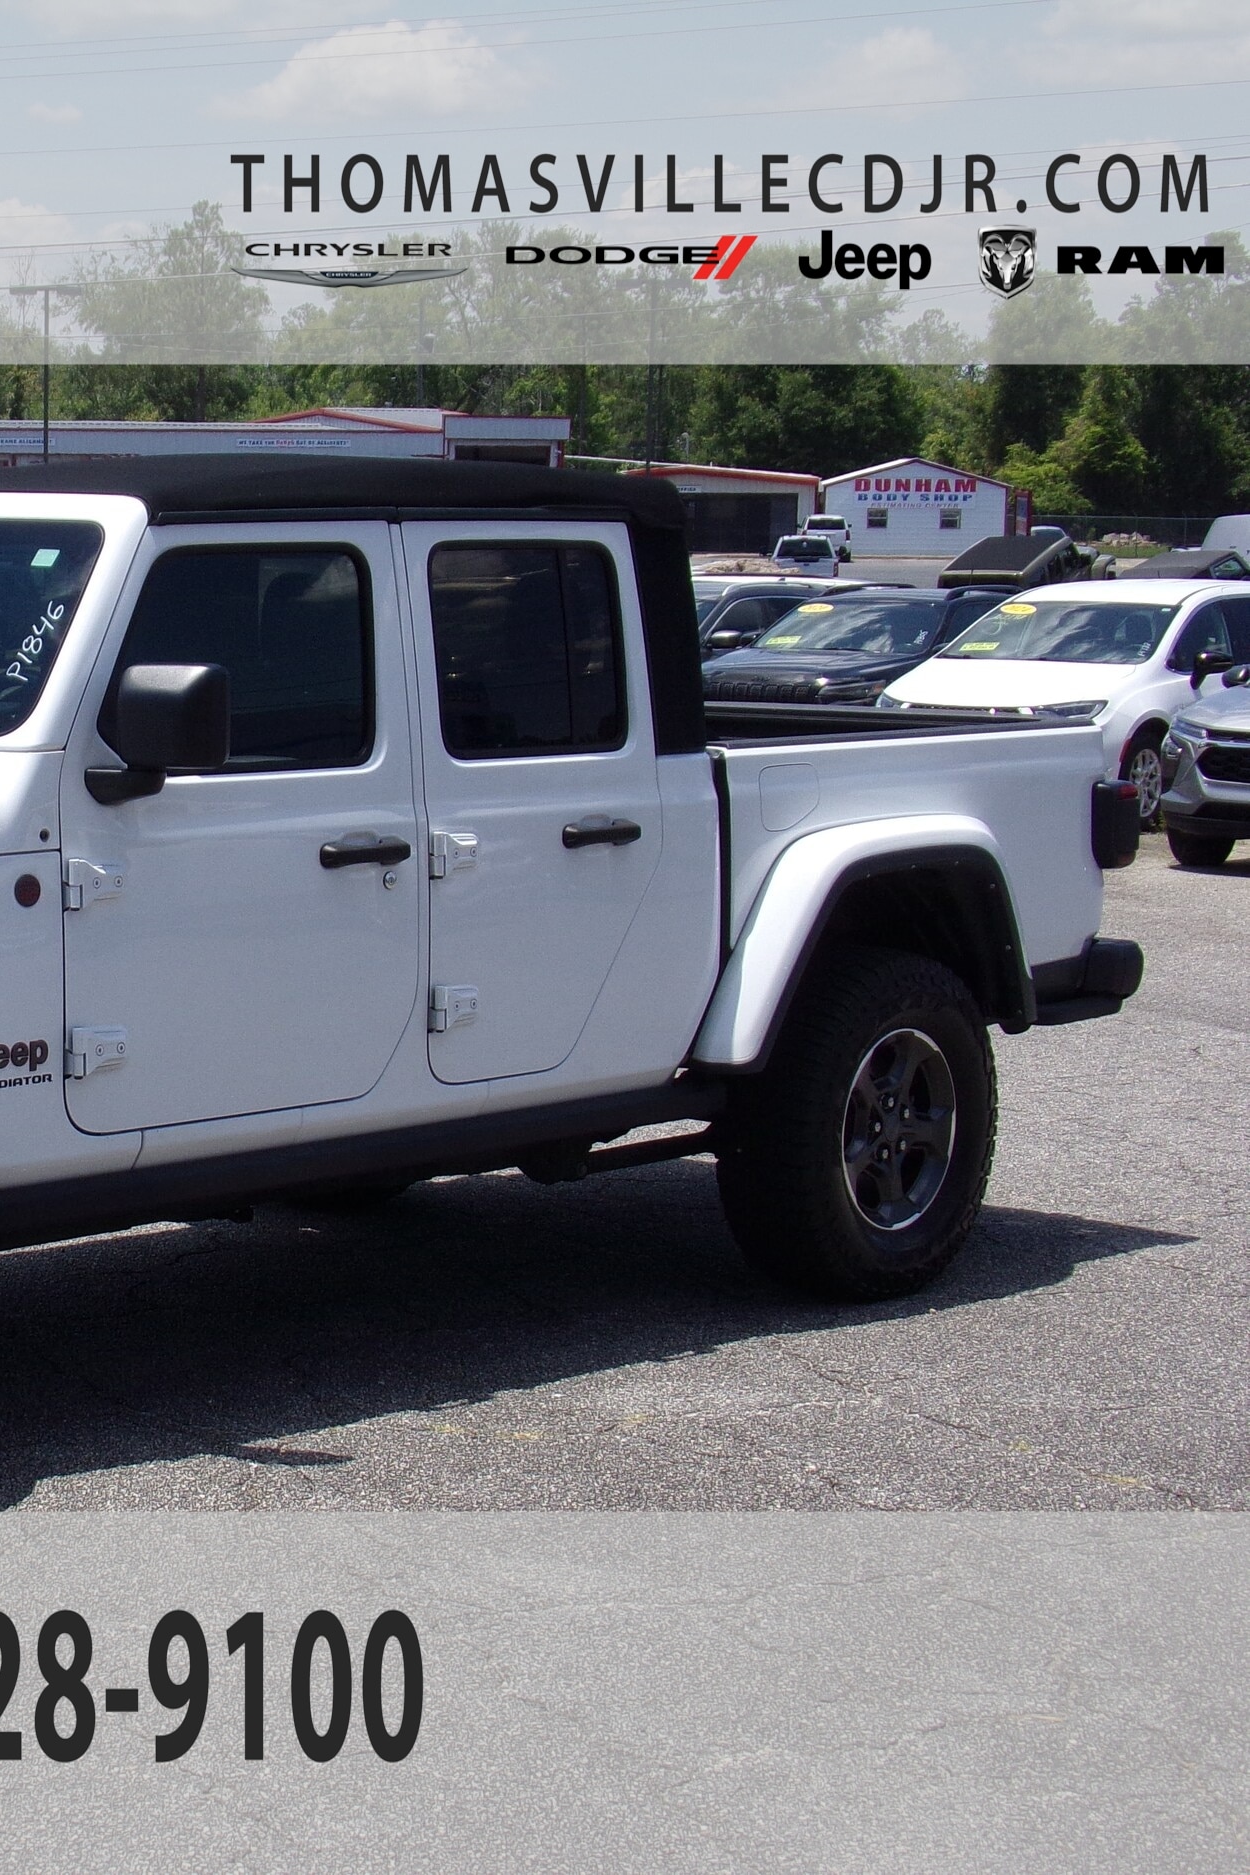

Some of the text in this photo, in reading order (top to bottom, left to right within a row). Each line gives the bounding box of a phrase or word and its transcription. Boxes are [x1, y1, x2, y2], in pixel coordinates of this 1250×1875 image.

[854, 478, 977, 492] DUNHAM
[857, 493, 973, 502] BODY SHOP
[6, 600, 65, 681] P1846
